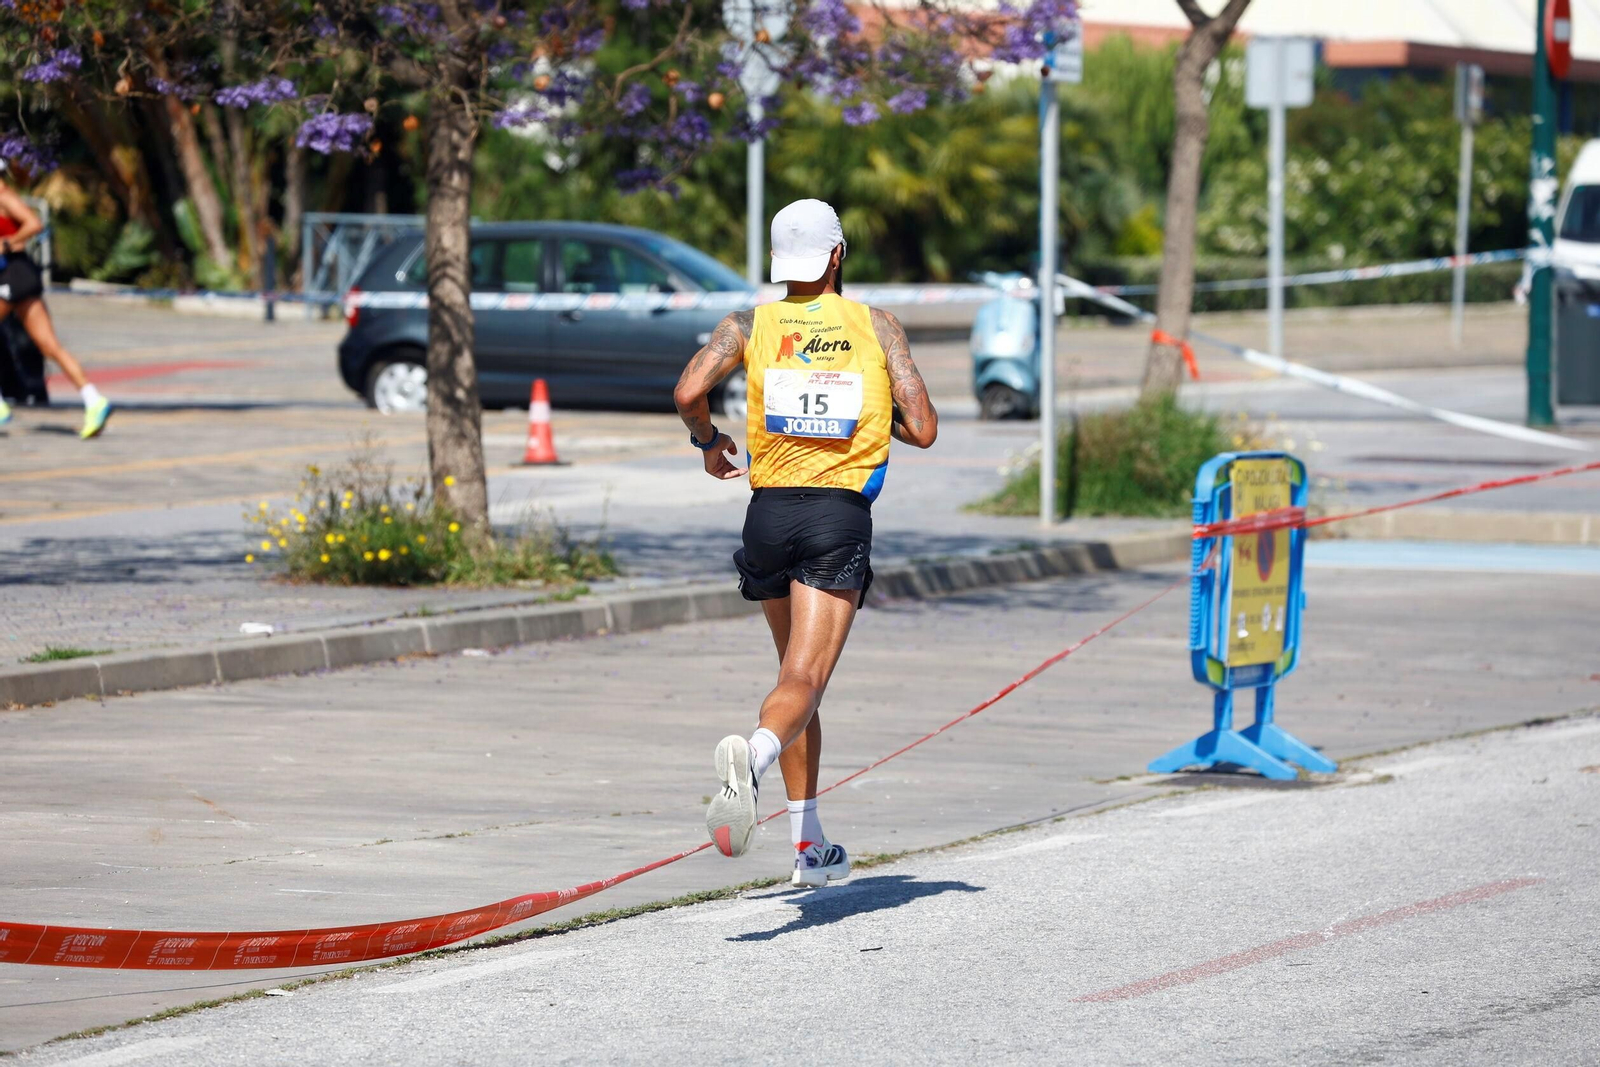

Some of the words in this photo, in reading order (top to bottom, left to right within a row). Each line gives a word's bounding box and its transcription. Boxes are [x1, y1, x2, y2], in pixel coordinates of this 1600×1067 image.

[810, 325, 842, 334] Guadalhorce
[803, 334, 851, 354] Álora
[798, 393, 829, 415] 15
